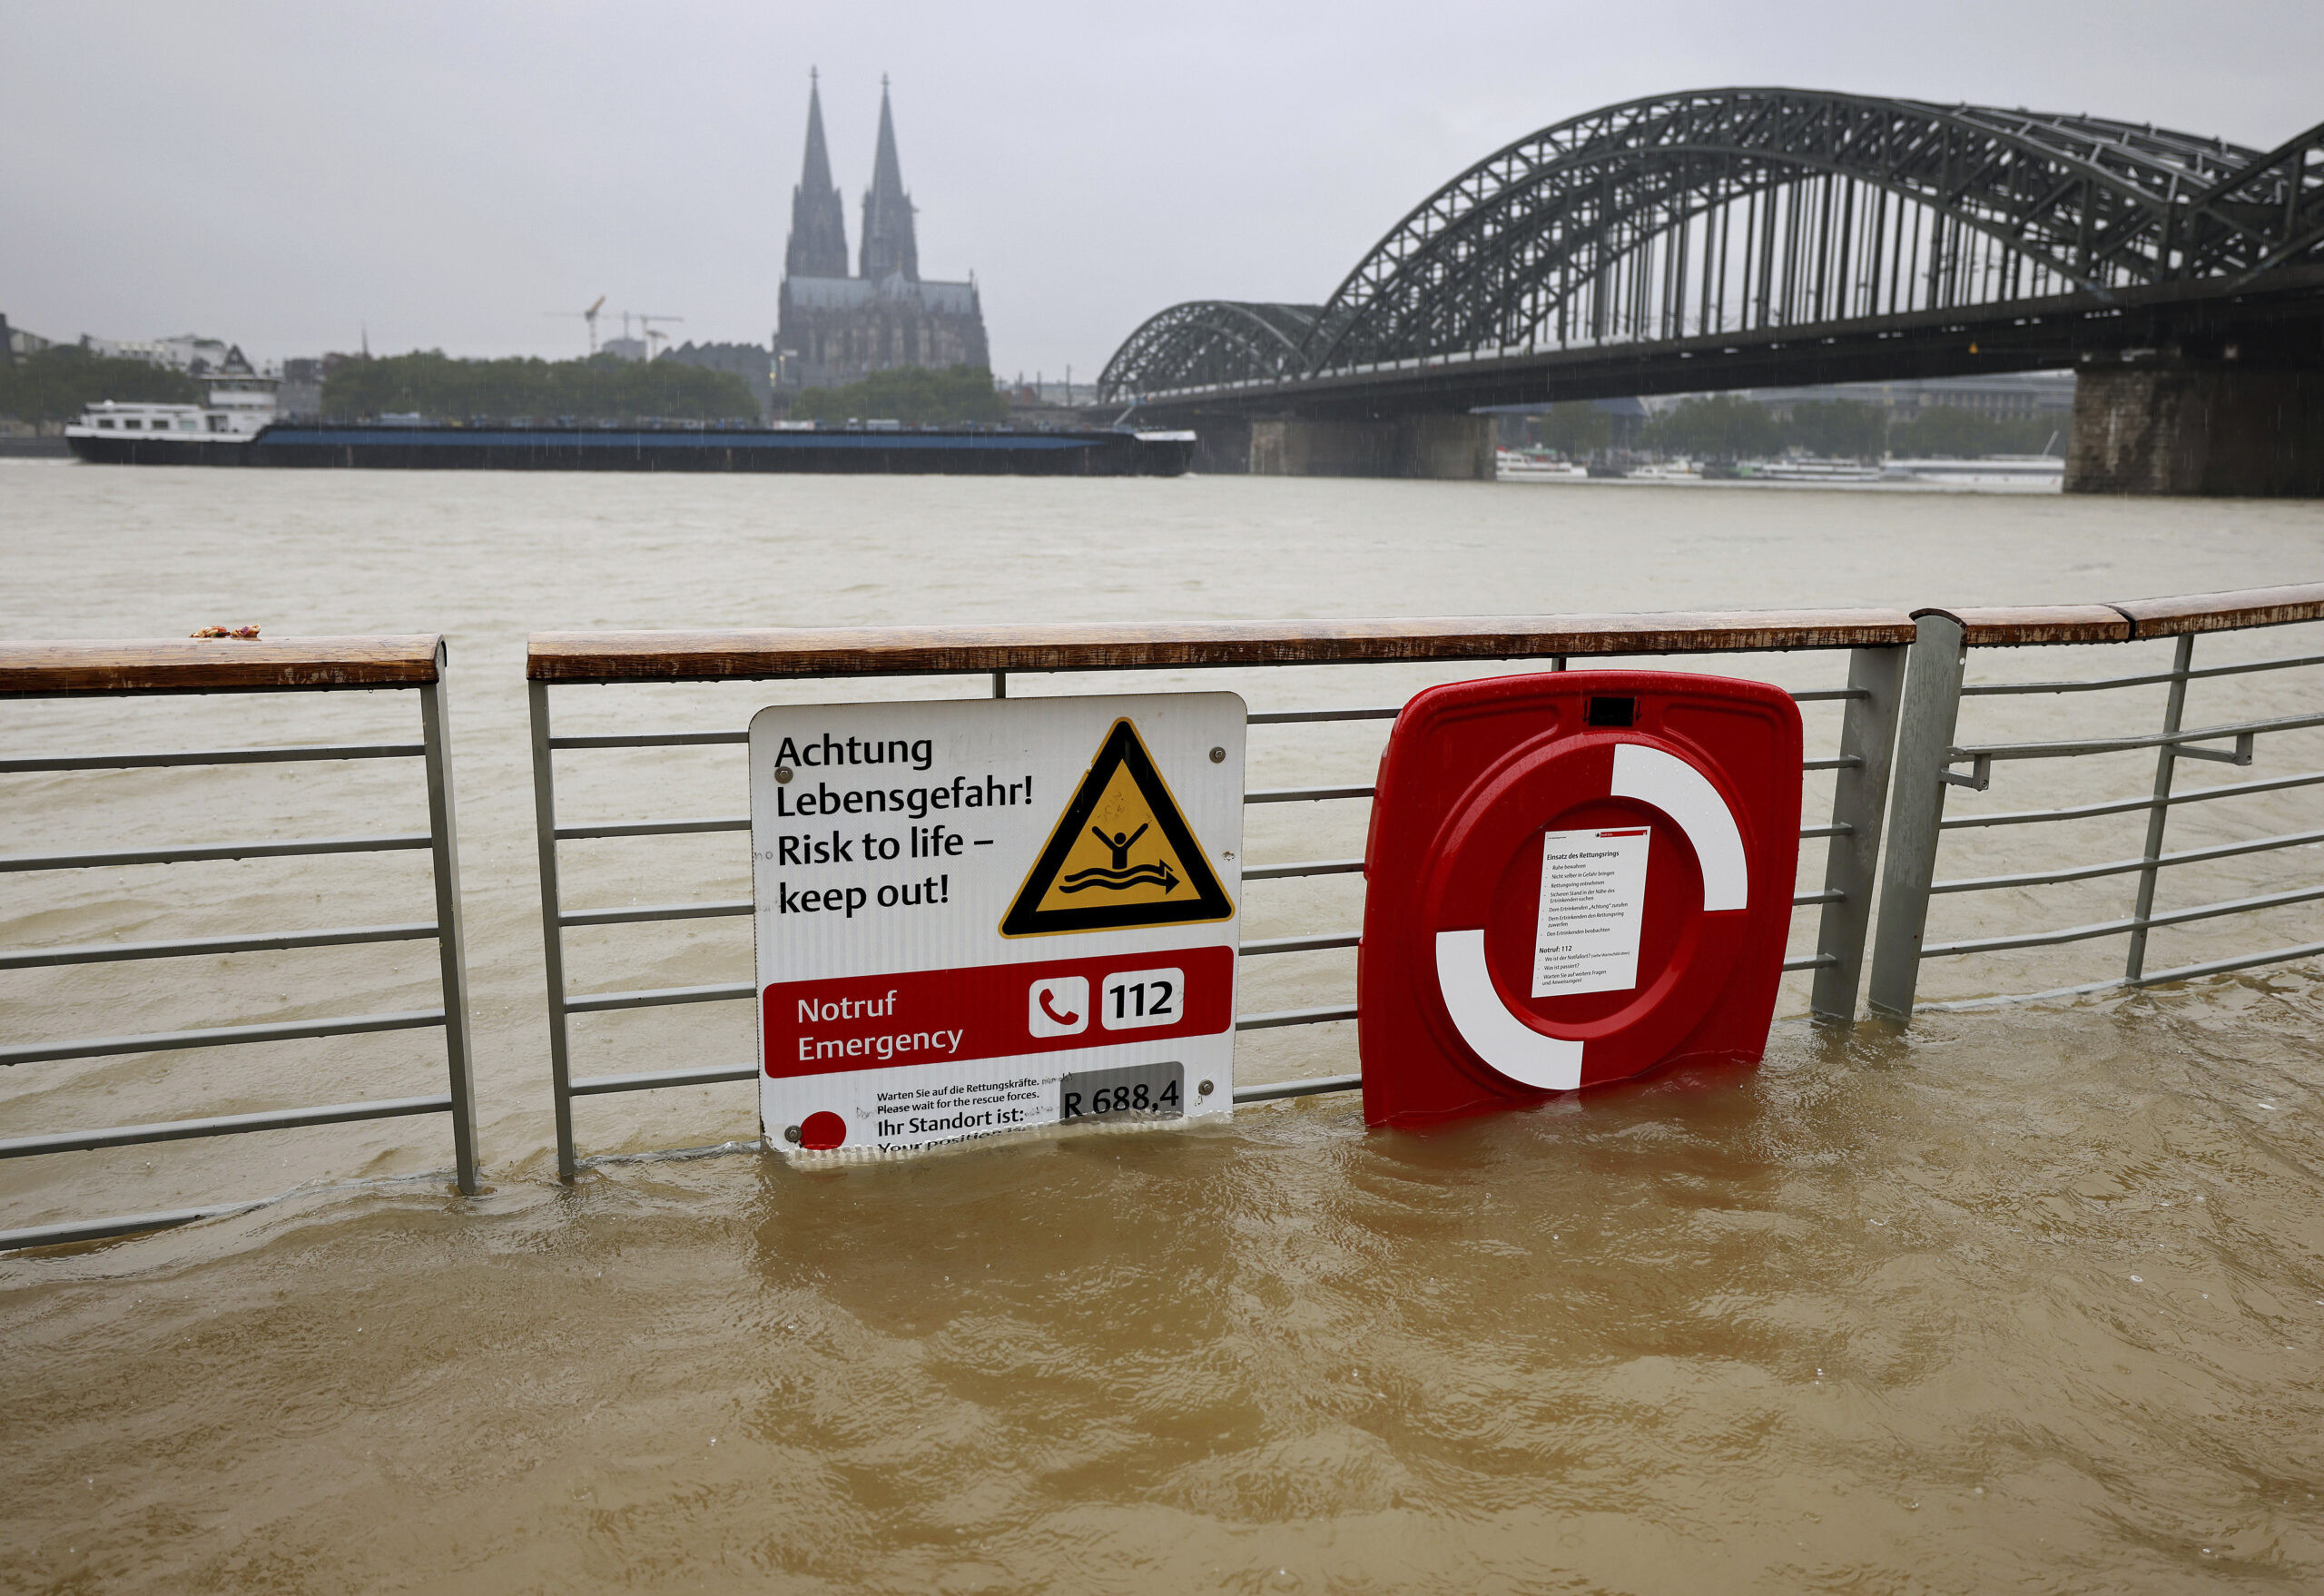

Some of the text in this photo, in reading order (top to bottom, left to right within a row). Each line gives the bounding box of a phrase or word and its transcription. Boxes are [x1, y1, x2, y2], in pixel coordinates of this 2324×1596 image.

[774, 734, 933, 770] Achtung
[776, 775, 1033, 819] Lebensgefahr!
[778, 830, 854, 866] Risk
[862, 832, 901, 861] to
[911, 825, 964, 859] life
[1579, 851, 1620, 859] Rettungsrings
[780, 874, 949, 918] keep out!
[798, 990, 898, 1023] Notruf
[1109, 980, 1174, 1019] 112
[798, 1028, 963, 1061] Emergency
[877, 1079, 1039, 1101] Warten Sie auf die Rettungskräfte.
[877, 1104, 911, 1115] Please
[911, 1101, 935, 1111] wait
[936, 1099, 952, 1109] for
[953, 1098, 970, 1108] the
[972, 1095, 1005, 1105] rescue
[1006, 1090, 1039, 1102] forces.
[1064, 1079, 1179, 1119] R 688,4
[877, 1119, 905, 1138] Ihr
[908, 1111, 993, 1134] Standort
[997, 1107, 1024, 1125] ist:
